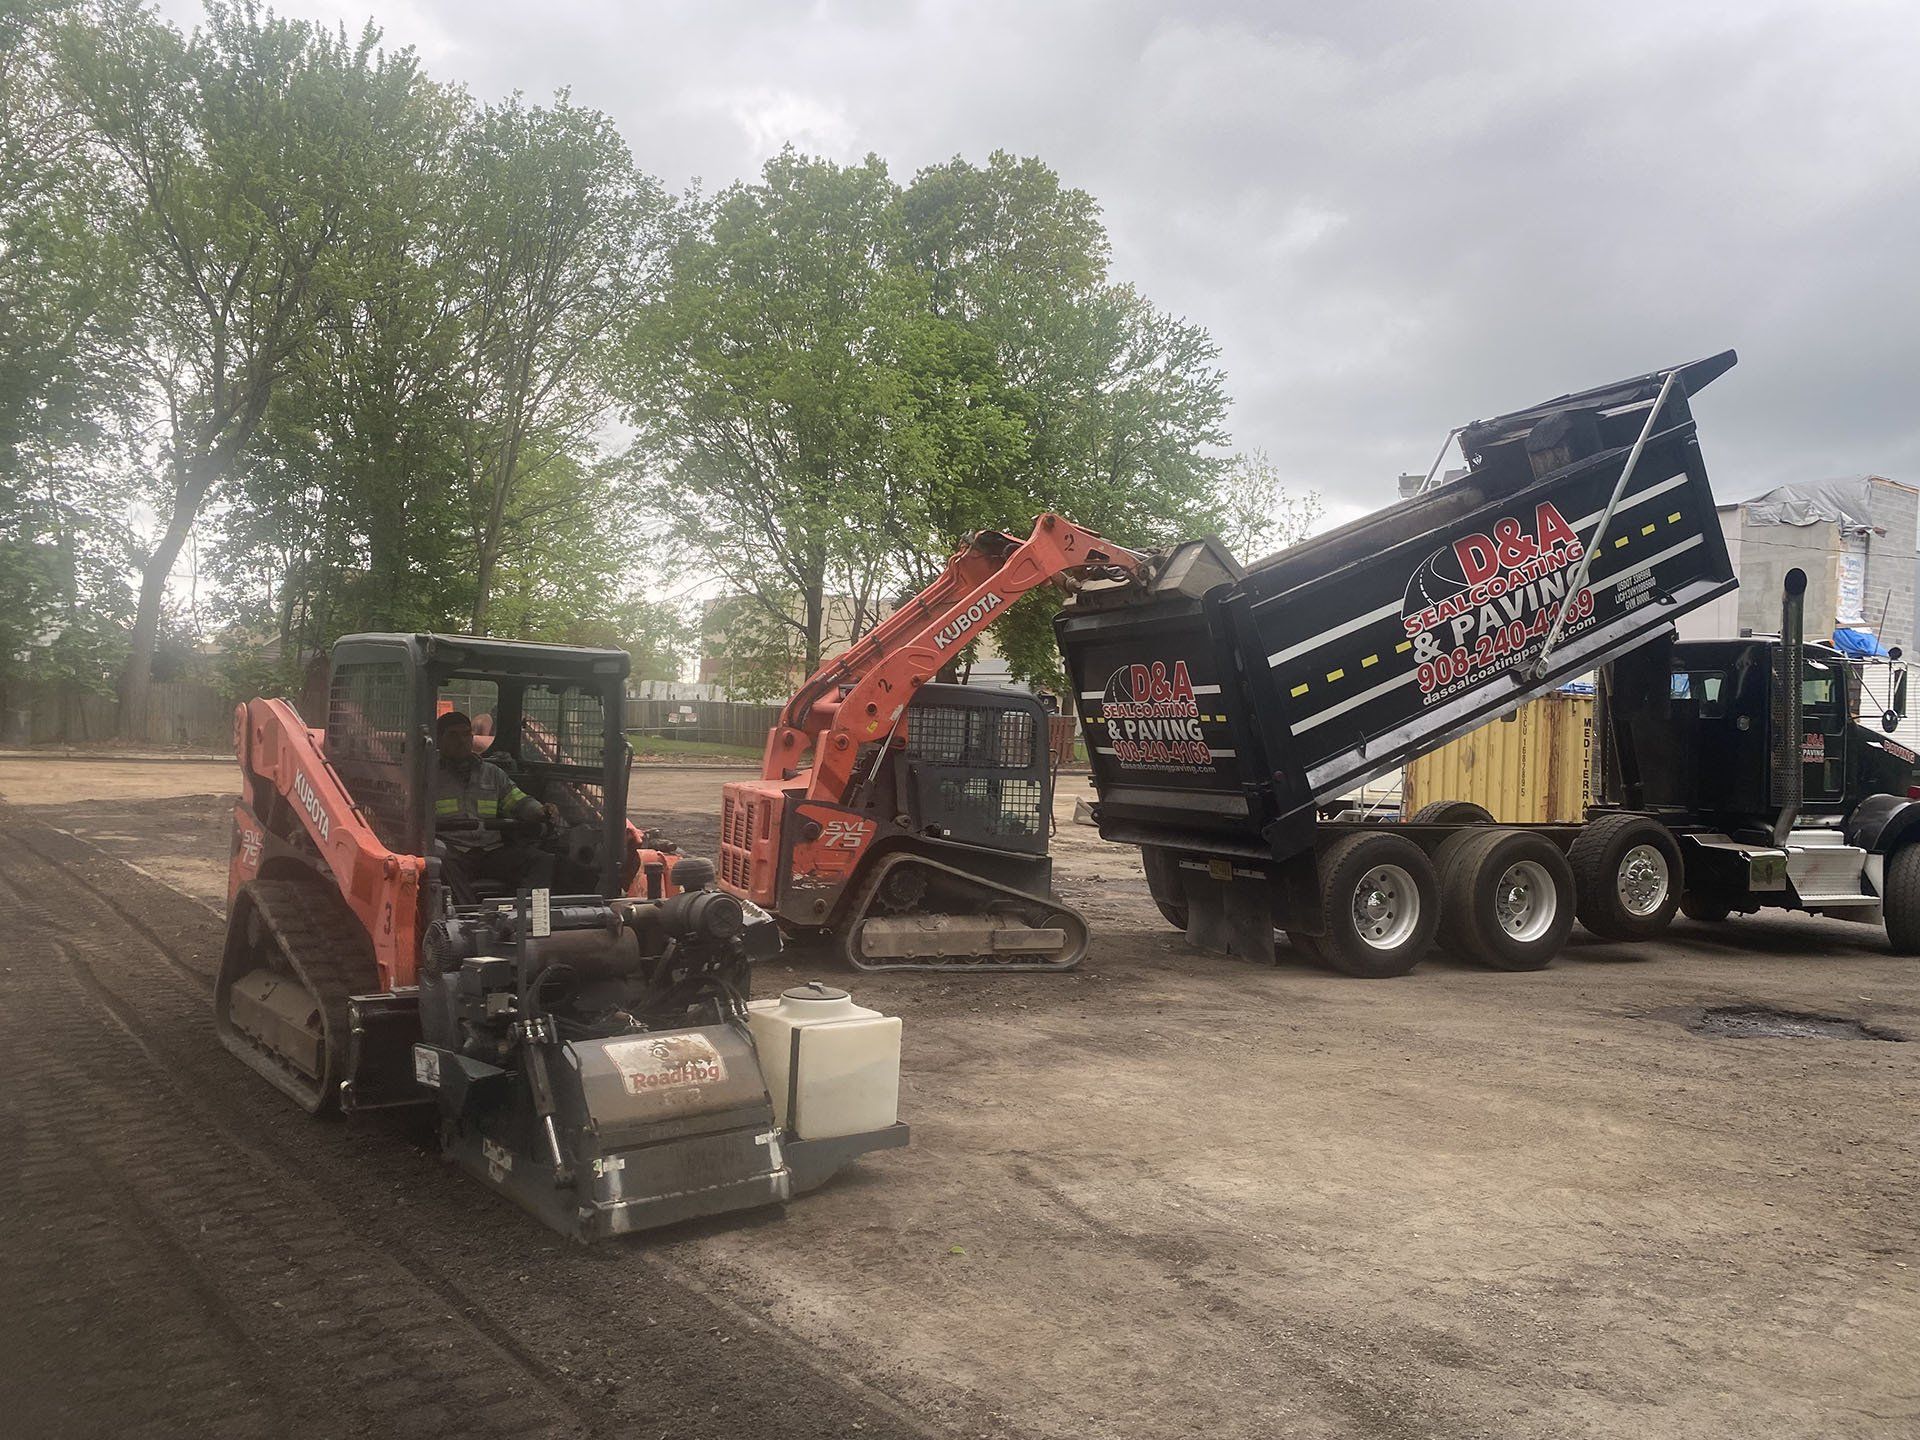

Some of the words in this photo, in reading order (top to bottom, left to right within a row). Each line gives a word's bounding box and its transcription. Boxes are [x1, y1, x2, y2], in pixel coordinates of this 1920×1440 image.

[1064, 534, 1074, 552] 2
[1453, 500, 1578, 587] D&A
[1403, 541, 1585, 638] SEALCOATING
[933, 591, 1002, 650] KUBOTA
[1413, 629, 1443, 664] &
[1451, 563, 1590, 646] PAVING
[1423, 615, 1596, 706] dasealcoatingpavg.com
[878, 678, 893, 693] 2
[1131, 660, 1195, 702] D&A
[1102, 701, 1199, 719] SEALCOATING
[1107, 719, 1123, 740] &
[1124, 718, 1204, 741] PAVING
[1112, 741, 1212, 765] 908-240-4169
[295, 768, 329, 842] KUBOTA
[826, 821, 871, 832] SVL
[825, 831, 862, 847] 75
[242, 844, 258, 866] 75
